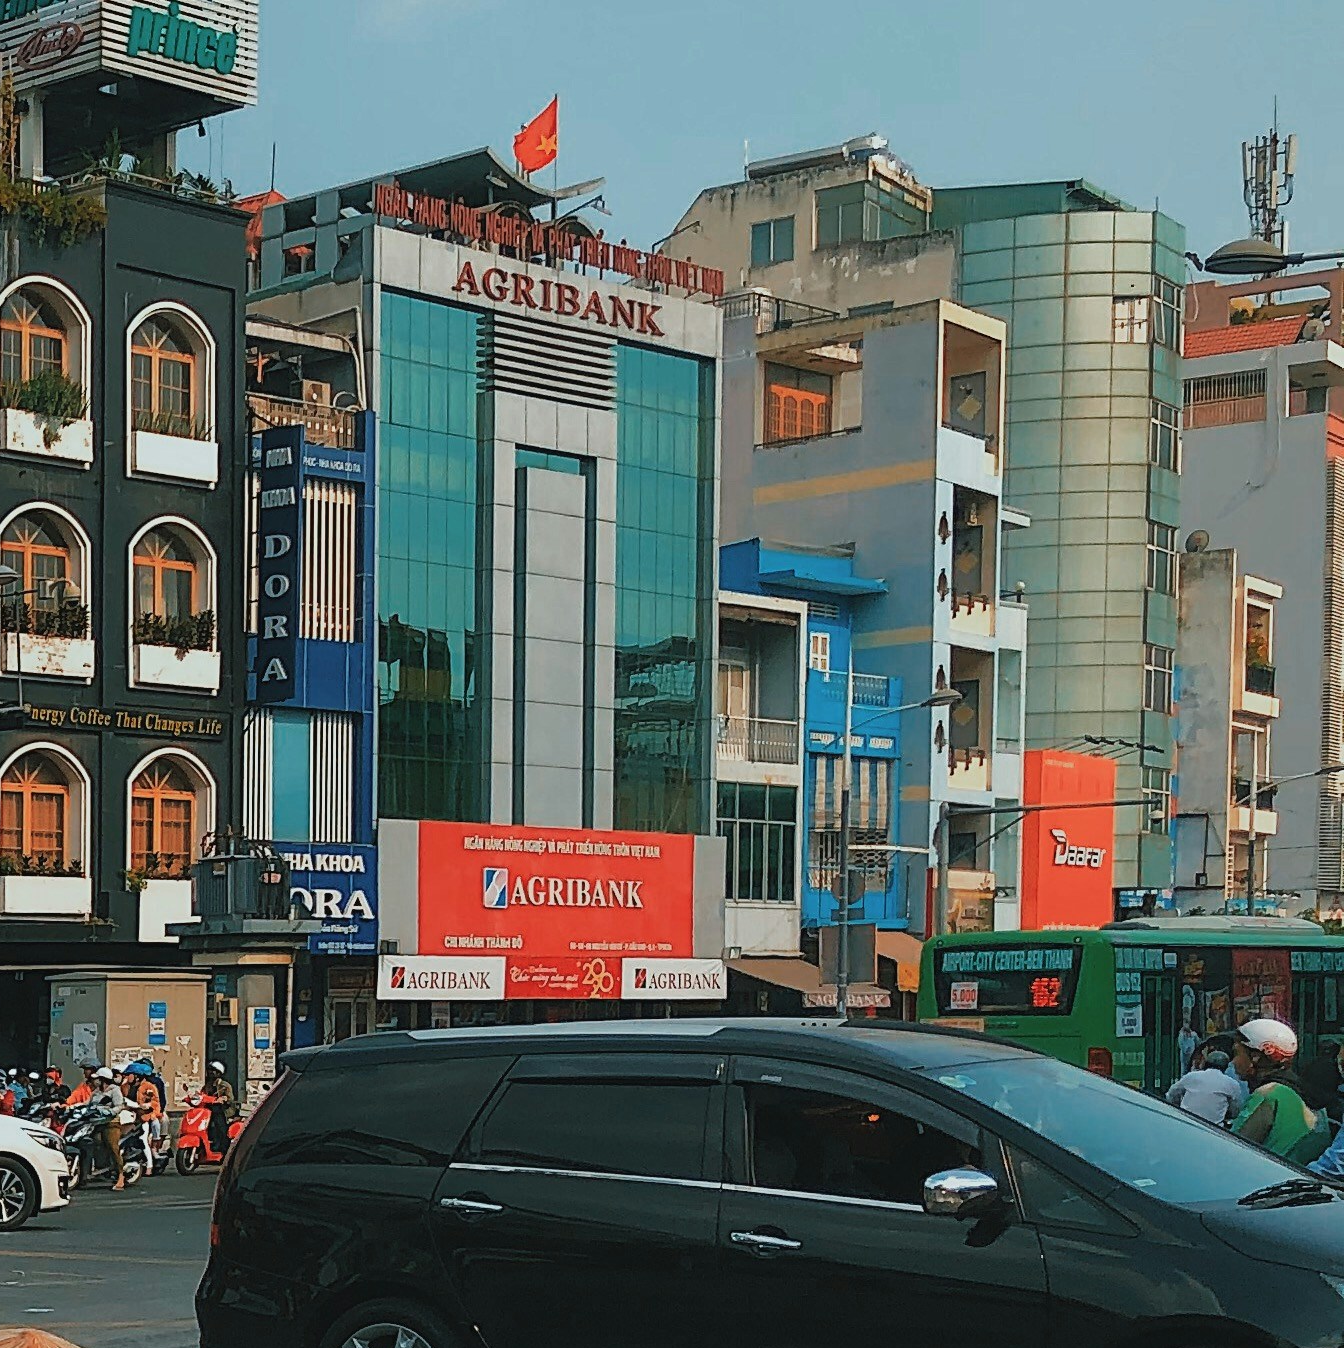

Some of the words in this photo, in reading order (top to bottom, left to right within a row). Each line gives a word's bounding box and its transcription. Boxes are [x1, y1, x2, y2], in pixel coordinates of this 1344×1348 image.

[128, 3, 238, 75] prince
[376, 179, 411, 220] NGÂN
[413, 192, 448, 230] HÀNG
[451, 196, 482, 239] NÔNG
[453, 261, 666, 337] AGRIBANK
[262, 534, 291, 683] DORA
[70, 707, 111, 727] Coffee
[116, 711, 142, 729] That
[145, 713, 194, 737] Changes
[198, 717, 222, 736] Life
[316, 854, 365, 873] KHOA
[511, 876, 644, 908] AGRIBANK
[943, 951, 993, 972] AIRPORT-CITY
[1046, 949, 1073, 970] THANH
[407, 970, 490, 990] AGRIBANK
[649, 969, 721, 990] AGRIBANK
[951, 988, 977, 1002] 5.000
